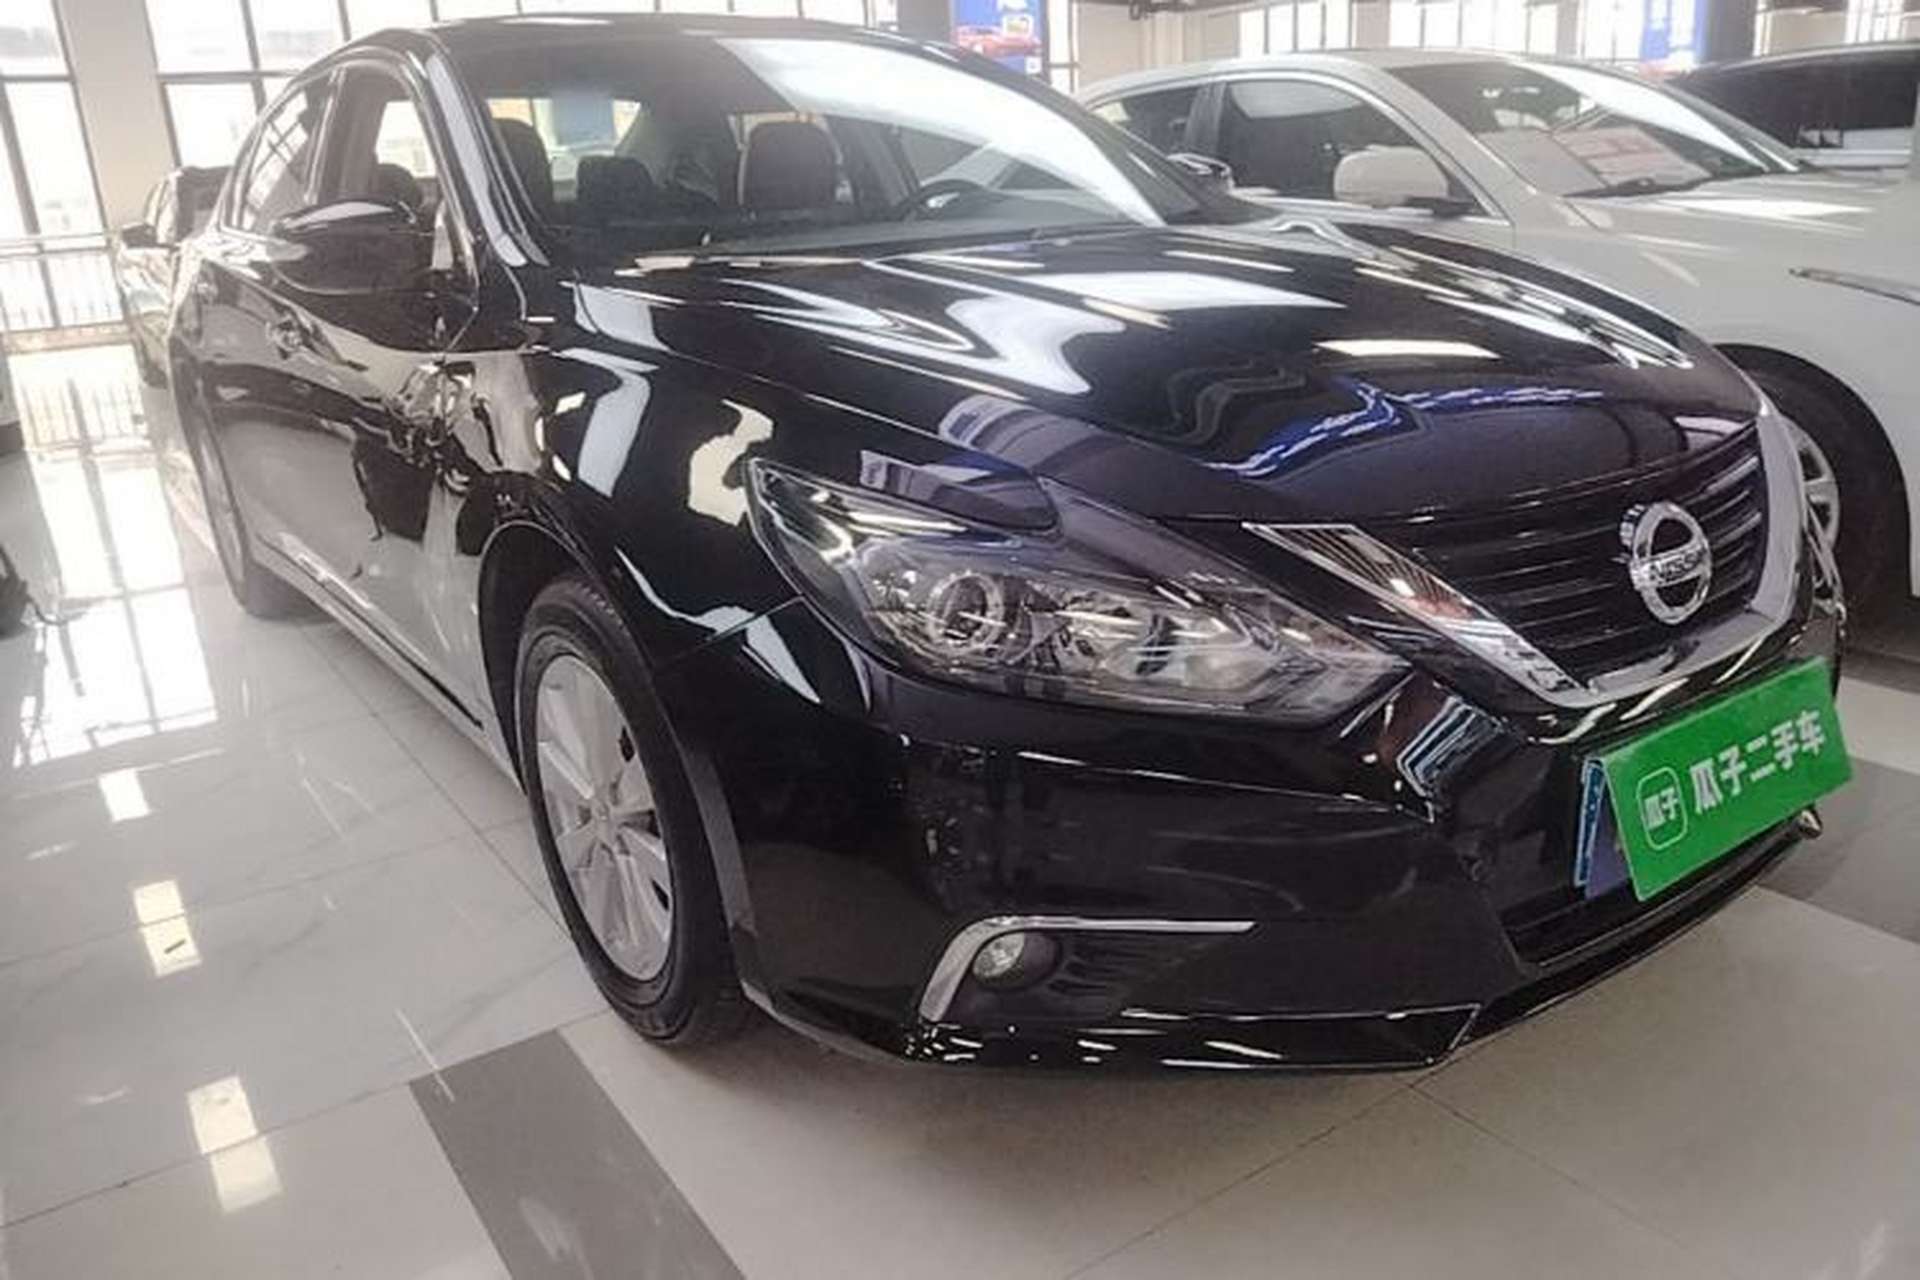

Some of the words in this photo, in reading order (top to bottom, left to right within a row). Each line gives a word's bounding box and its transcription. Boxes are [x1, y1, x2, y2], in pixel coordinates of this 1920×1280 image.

[1690, 710, 1825, 814] 瓜子二手车
